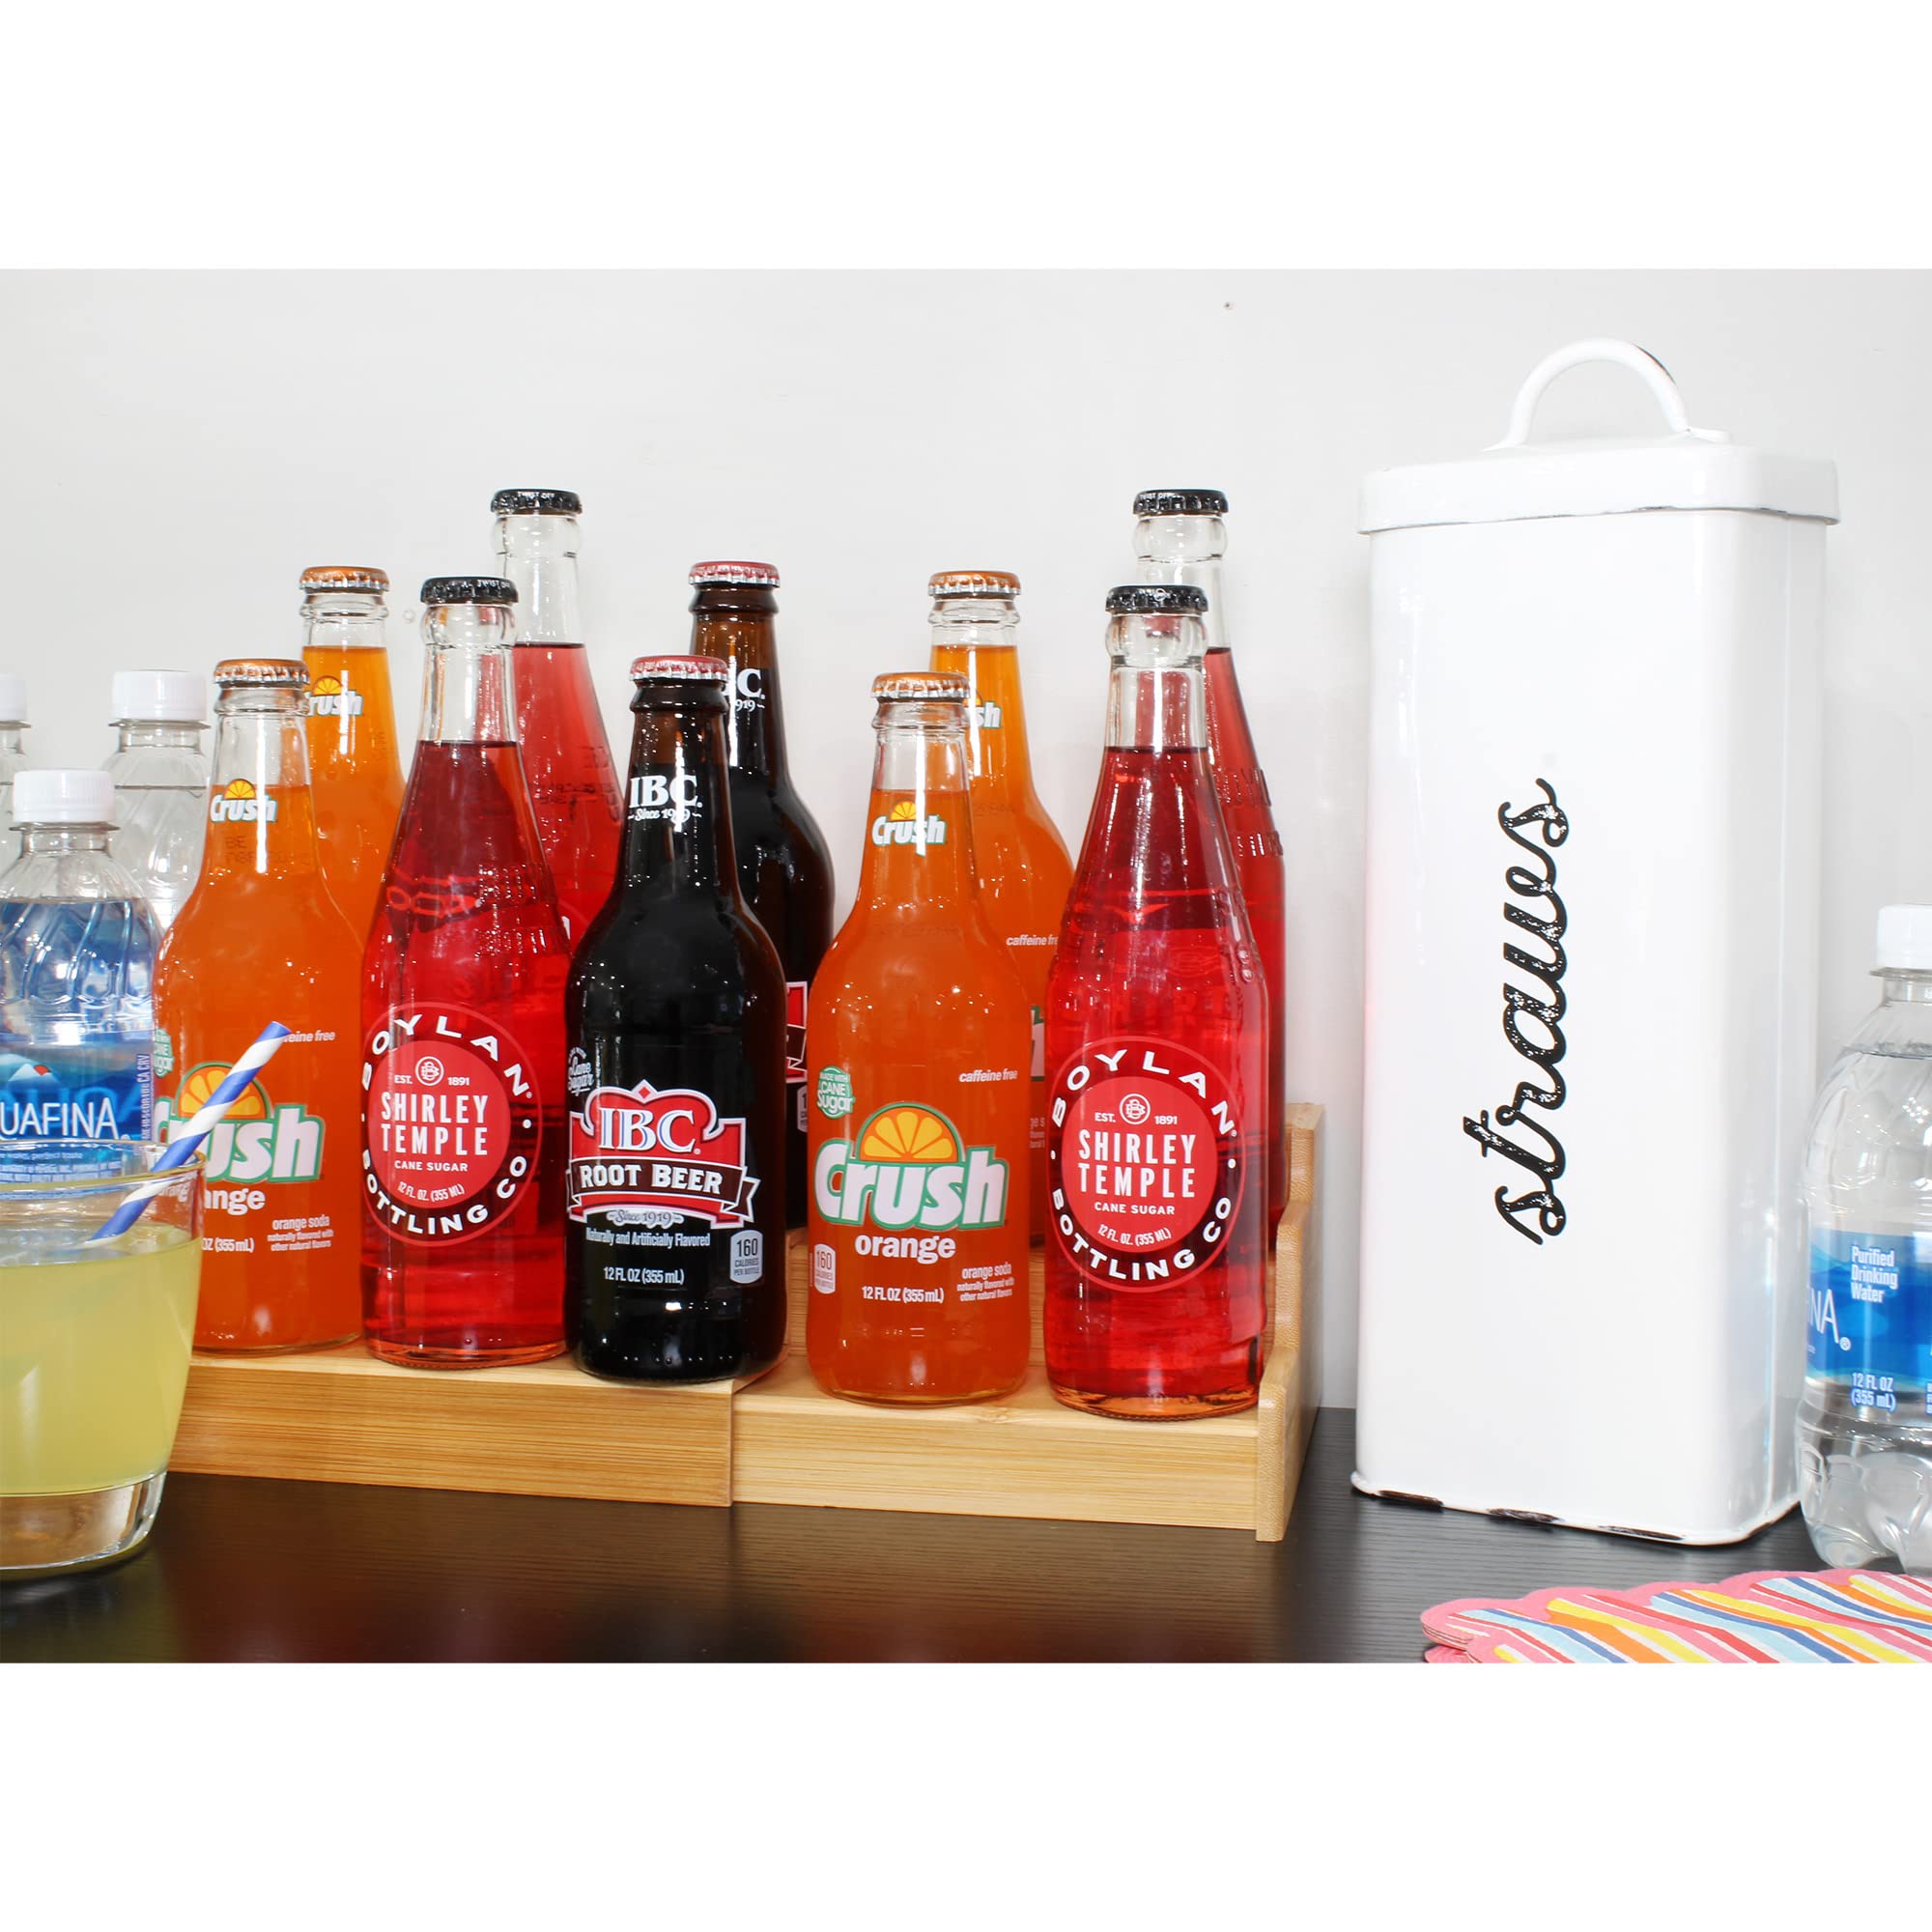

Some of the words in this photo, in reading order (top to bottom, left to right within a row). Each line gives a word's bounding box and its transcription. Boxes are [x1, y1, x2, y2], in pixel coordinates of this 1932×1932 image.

[735, 698, 755, 713] 919
[629, 774, 698, 810] IBC
[634, 808, 661, 822] Since
[661, 808, 692, 825] 199
[1006, 933, 1047, 947] caffeine
[1463, 777, 1570, 1246] straws
[314, 1029, 336, 1042] free
[361, 1013, 530, 1099] BOYLAN
[394, 1074, 413, 1085] EST.
[447, 1076, 470, 1086] 1891
[958, 1067, 1003, 1083] caffeine
[821, 1081, 846, 1096] CANE
[1051, 1048, 1236, 1136] BOYLAN
[380, 1091, 489, 1124] SHIRLEY
[817, 1090, 853, 1113] Sugar
[0, 1096, 121, 1141] UAFINA
[1094, 1112, 1117, 1123] EST.
[1154, 1115, 1178, 1125] 1891
[381, 1122, 489, 1156] TEMPLE
[598, 1107, 696, 1153] IBC
[1078, 1128, 1197, 1165] SHIRLEY
[394, 1159, 423, 1171] CANE
[426, 1161, 469, 1172] SUGAR
[397, 1180, 408, 1194] 12
[580, 1164, 642, 1190] ROOT
[651, 1163, 724, 1195] BEER
[814, 1140, 1009, 1231] Crush
[1078, 1162, 1196, 1199] TEMPLE
[361, 1149, 489, 1236] BOTTLING
[642, 1210, 672, 1225] 1919
[1094, 1202, 1126, 1214] CANE
[1130, 1205, 1176, 1215] SUGAR
[272, 1218, 308, 1232] orange
[1052, 1188, 1197, 1281] BOTTLING
[1097, 1223, 1109, 1237] 12
[1134, 1232, 1155, 1247] (355
[214, 1236, 235, 1253] (355
[235, 1236, 255, 1253] mL)
[615, 1232, 631, 1244] and
[631, 1232, 674, 1250] Artificially
[675, 1234, 711, 1247] Flavored
[737, 1237, 759, 1258] 160
[854, 1235, 956, 1264] orange
[816, 1251, 832, 1271] 160
[1850, 1244, 1895, 1268] Purified
[603, 1266, 615, 1281] 12
[615, 1267, 627, 1282] FL
[628, 1268, 641, 1283] OZ
[641, 1267, 665, 1285] (355
[665, 1268, 685, 1285] mL)
[961, 1266, 994, 1281] orange
[1850, 1264, 1899, 1291] Drinking
[861, 1285, 873, 1300] 12
[874, 1286, 887, 1301] FL
[887, 1287, 901, 1302] OZ
[901, 1287, 924, 1304] (355
[924, 1287, 945, 1304] mL)
[1850, 1282, 1886, 1304] Water
[1851, 1371, 1864, 1388] 12
[1864, 1376, 1878, 1391] FL
[1879, 1376, 1894, 1393] OZ
[1850, 1389, 1876, 1407] (355
[1876, 1391, 1897, 1413] mL)
